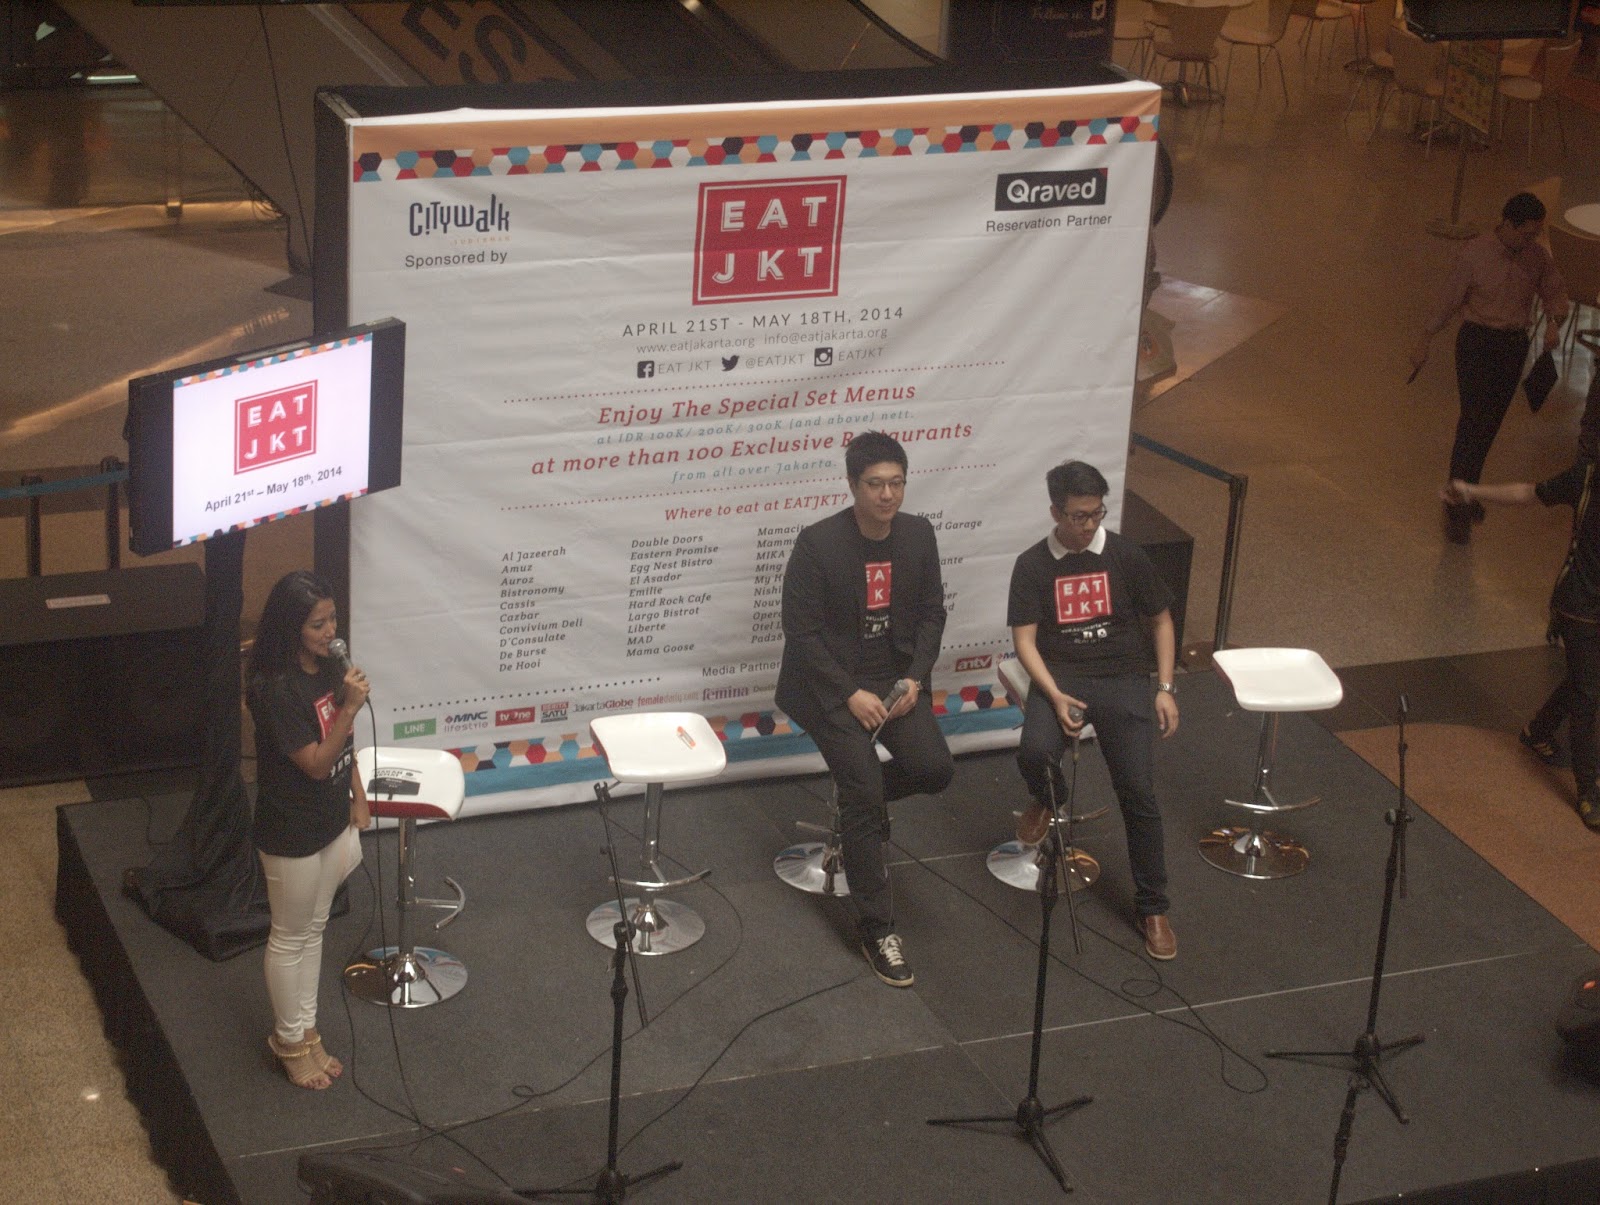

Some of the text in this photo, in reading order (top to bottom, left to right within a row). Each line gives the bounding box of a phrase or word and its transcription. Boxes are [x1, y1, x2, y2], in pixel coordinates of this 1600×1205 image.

[1006, 177, 1097, 203] Qraved
[720, 196, 827, 233] EAT
[985, 212, 1113, 233] Reservation Partner
[405, 250, 508, 270] Sponsored by
[712, 247, 823, 284] JKT
[622, 322, 678, 338] APRIL
[686, 317, 731, 333] 21ST
[752, 313, 792, 329] MAY
[800, 310, 851, 326] 18TH,
[860, 306, 904, 322] 2014
[636, 326, 888, 355] www.eatjakarta.org info@eatjakarta.org
[745, 353, 806, 369] @EATJKT
[838, 346, 885, 363] EATJKT
[658, 360, 713, 375] EAT JKT
[247, 394, 308, 428] EAT
[597, 385, 916, 427] Enjoy The Special Set Menus
[597, 434, 612, 445] at
[618, 431, 644, 444] IDR
[747, 419, 783, 433] 300K
[244, 425, 307, 460] JKT
[531, 457, 556, 475] at
[563, 454, 621, 473] more
[628, 447, 680, 467] than
[687, 444, 724, 461] 100
[730, 432, 834, 458] Exclusive
[671, 470, 706, 484] from
[713, 467, 733, 478] all
[739, 464, 770, 476] over
[205, 495, 232, 512] April
[234, 488, 255, 504] 21st
[267, 481, 289, 497] May
[317, 466, 343, 482] 2014
[664, 506, 712, 521] Where
[717, 505, 732, 517] to
[736, 501, 759, 515] eat
[764, 500, 779, 512] at
[945, 520, 983, 531] Garage
[631, 535, 704, 549] Double Doors
[517, 546, 567, 562] Jazeerah
[630, 545, 719, 561] Eastern Promise
[756, 549, 785, 561] MIKA
[501, 564, 533, 575] Amuz
[630, 557, 713, 575] Egg Nest Bistro
[755, 562, 783, 574] Ming
[643, 572, 683, 584] Asador
[754, 575, 771, 586] My
[500, 585, 565, 598] Bistronomy
[1063, 580, 1102, 597] EAT
[500, 599, 536, 611] Cassis
[628, 592, 712, 610] Hard Rock Cafe
[1064, 600, 1104, 616] JKT
[628, 606, 700, 623] Largo Bistrot
[499, 622, 558, 635] Convivium
[627, 622, 667, 634] Liberte
[752, 620, 774, 632] Otel
[627, 635, 653, 646] MAD
[499, 647, 547, 661] De Burse
[626, 643, 695, 658] Mama Goose
[499, 663, 513, 672] De
[702, 665, 736, 677] Media
[702, 685, 750, 701] femina
[453, 711, 489, 723] MNC
[542, 709, 568, 719] SATU
[404, 724, 426, 735] LINE
